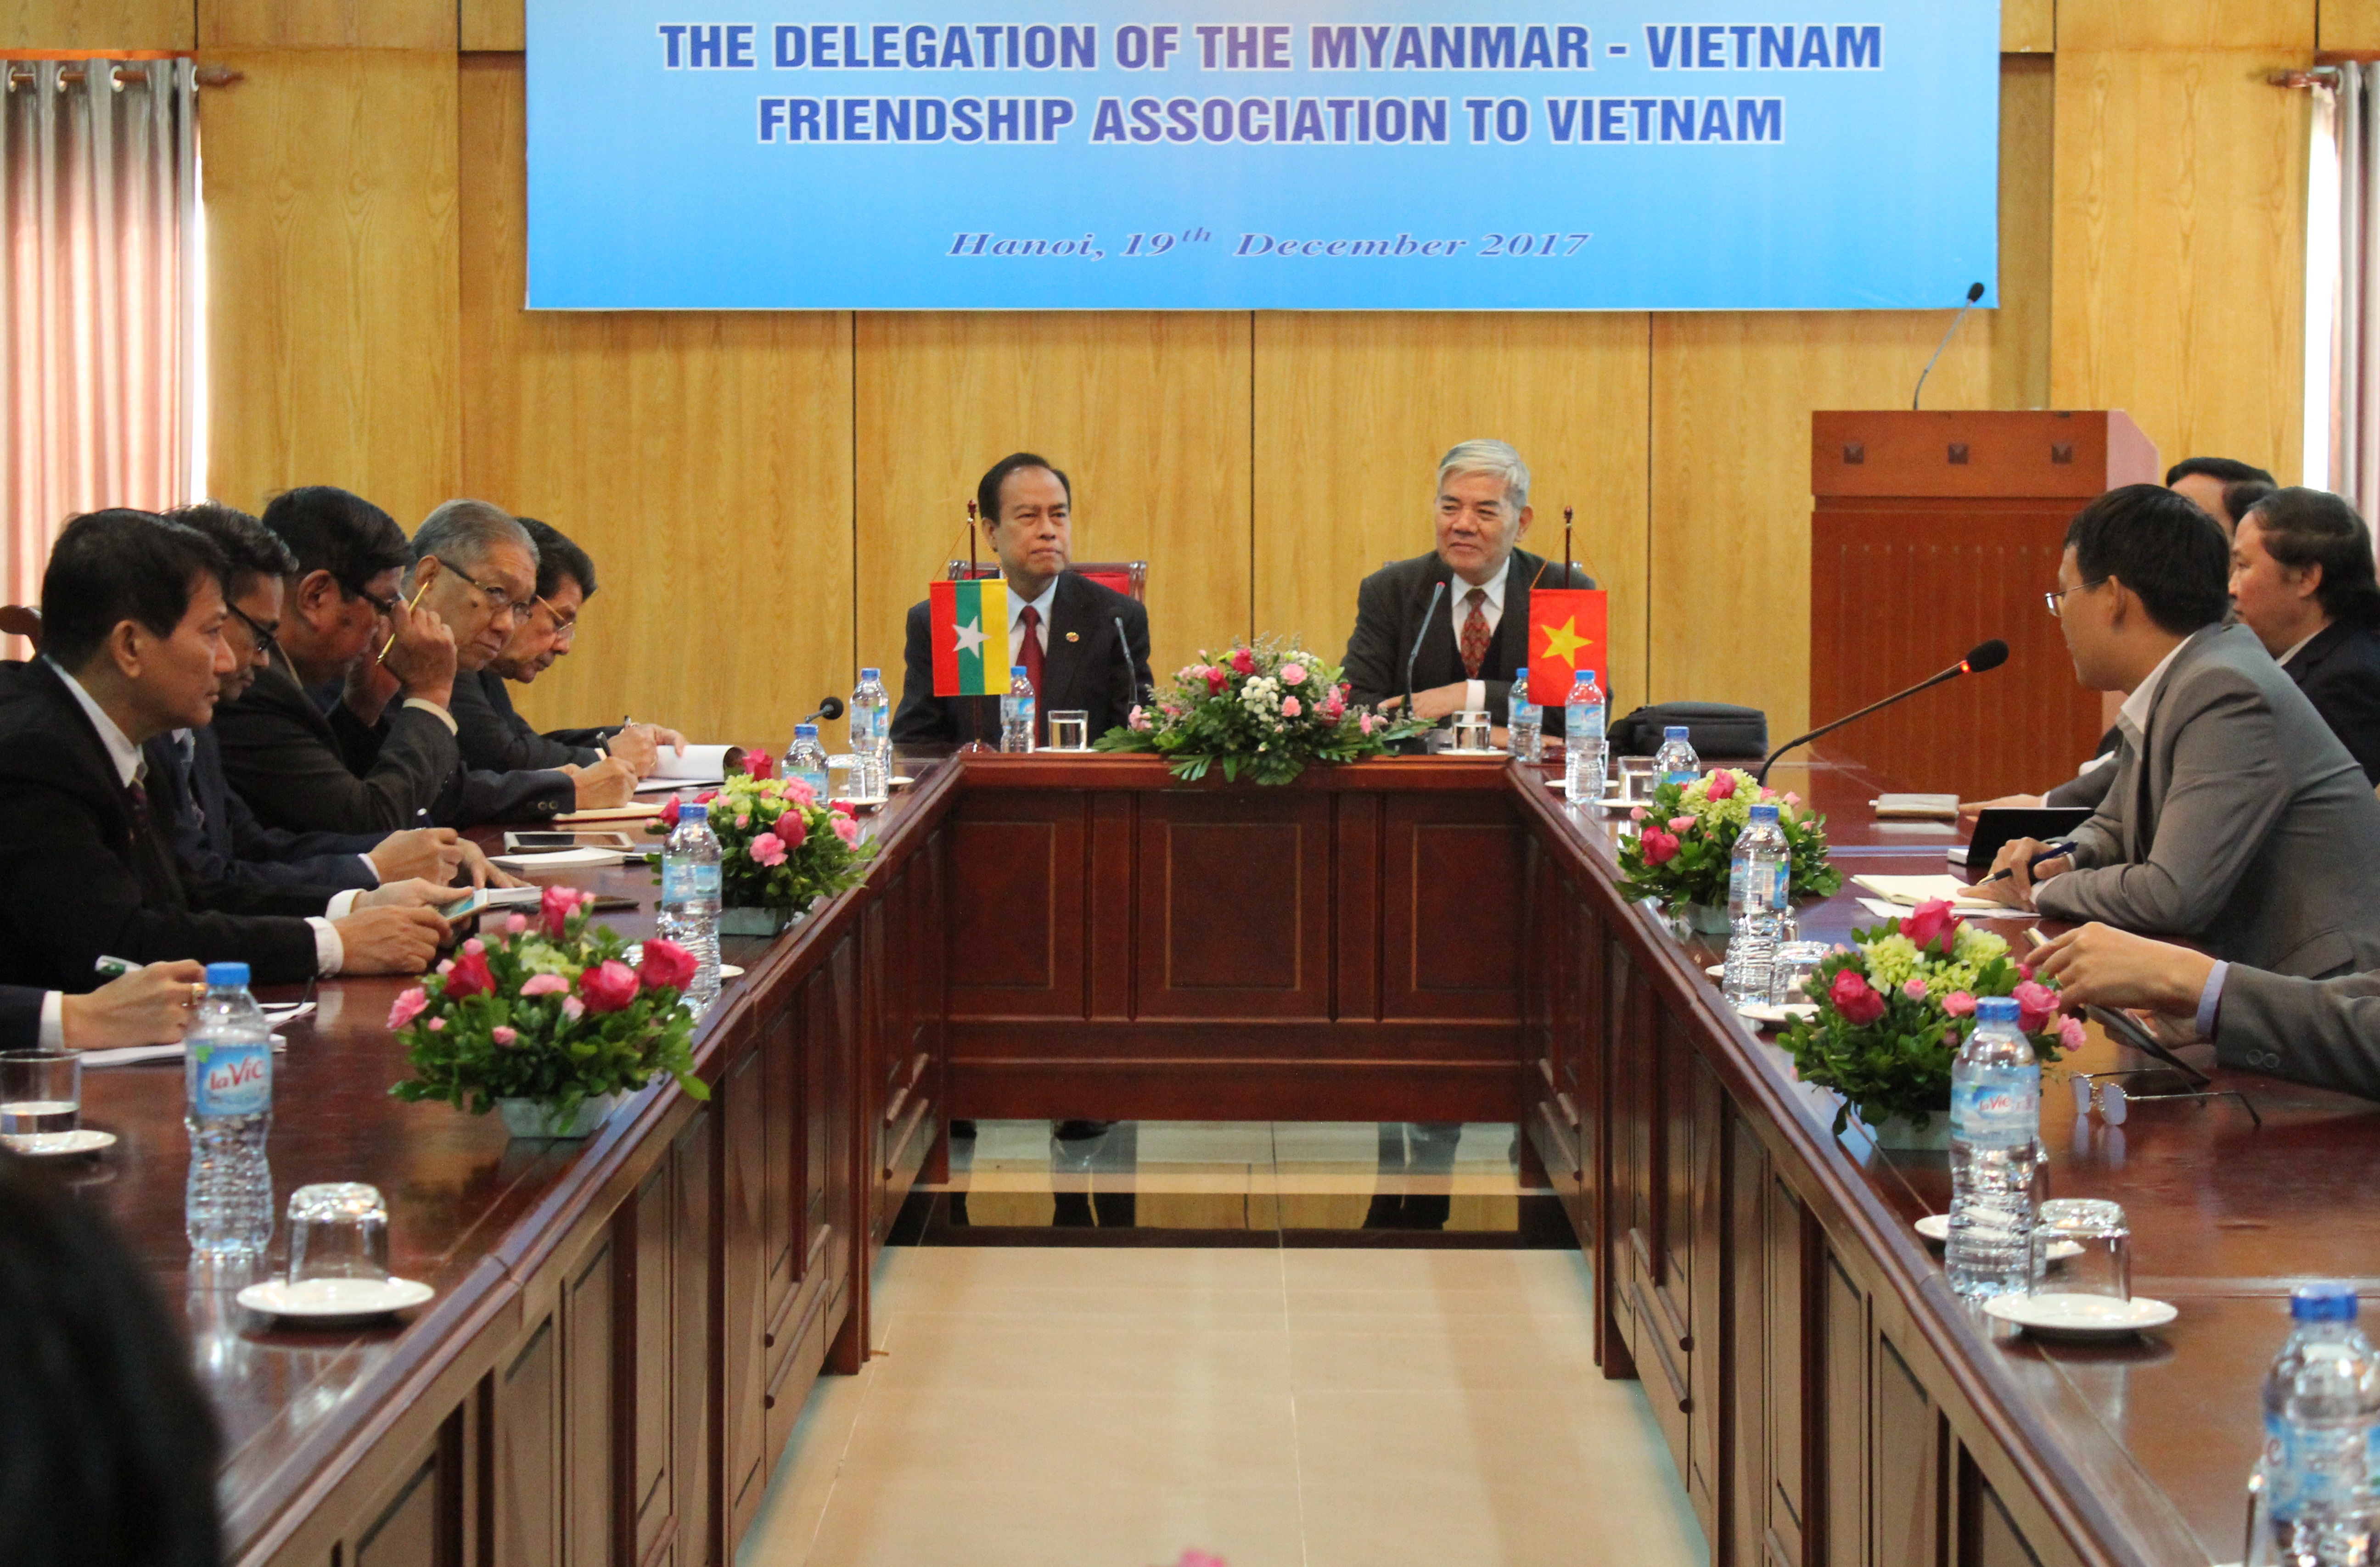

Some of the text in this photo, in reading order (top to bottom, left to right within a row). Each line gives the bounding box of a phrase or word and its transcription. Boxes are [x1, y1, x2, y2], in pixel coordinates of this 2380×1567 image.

[657, 23, 755, 69] THE
[774, 23, 1096, 70] DELEGATION
[1115, 23, 1179, 70] OF
[1194, 24, 1291, 69] THE
[1310, 24, 1589, 70] MYANMAR
[1645, 24, 1881, 69] VIETNAM
[758, 97, 1782, 143] FRIENDSHIP ASSOCIATION TO VIETNAM
[947, 232, 1105, 261] Hanoi,
[1233, 233, 1467, 257] December
[1476, 233, 1592, 257] 2017
